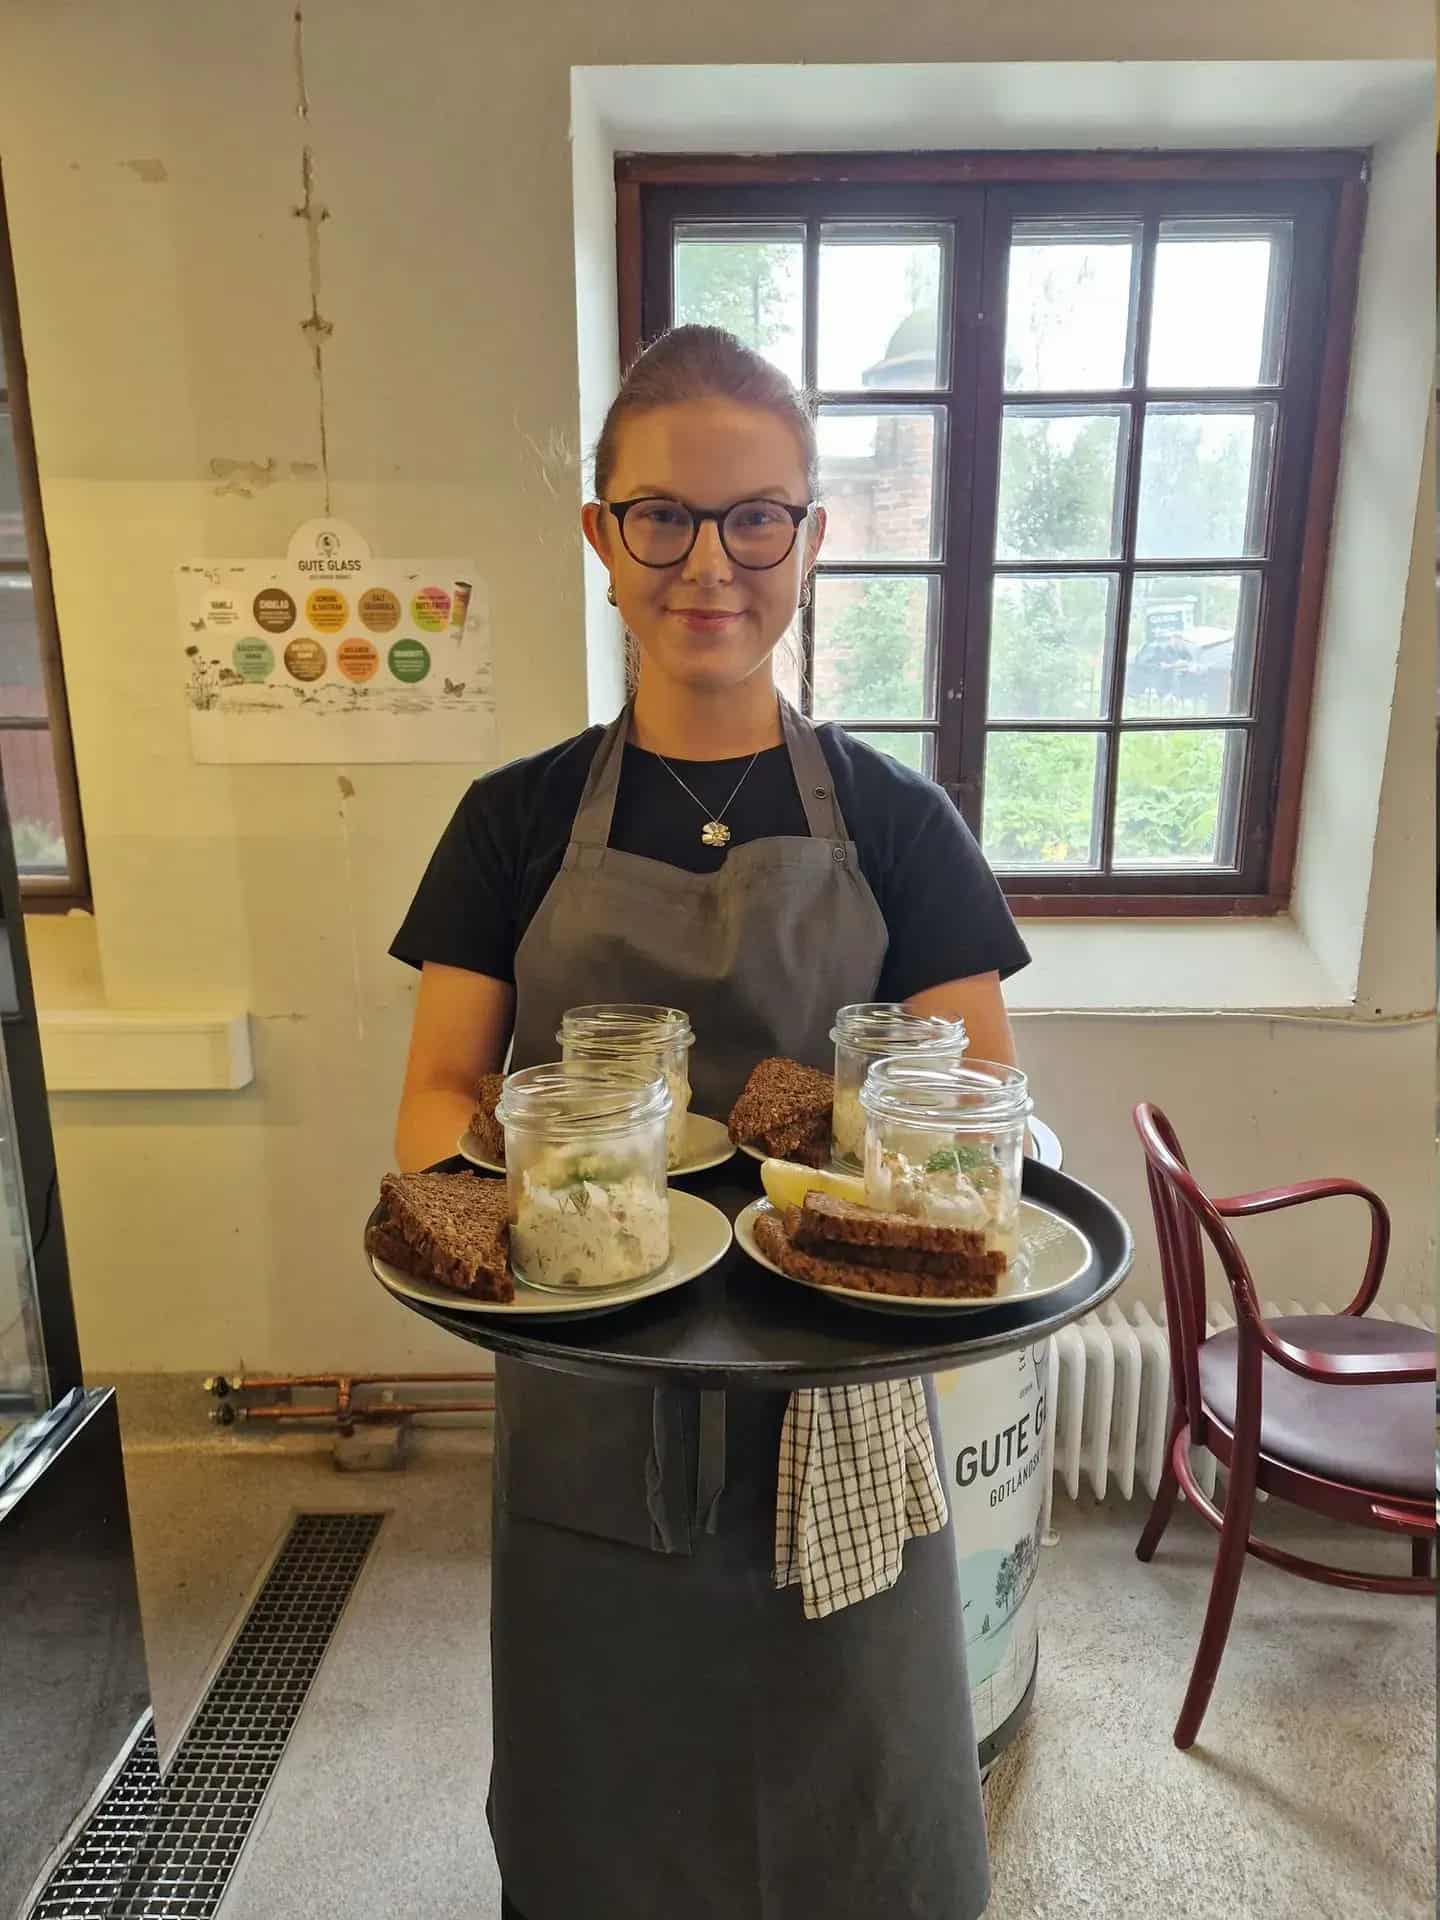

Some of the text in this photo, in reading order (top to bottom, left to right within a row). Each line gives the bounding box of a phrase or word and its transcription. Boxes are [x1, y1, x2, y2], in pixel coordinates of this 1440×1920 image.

[298, 559, 362, 572] GUTE GLASS
[955, 1413, 1030, 1488] GUTE
